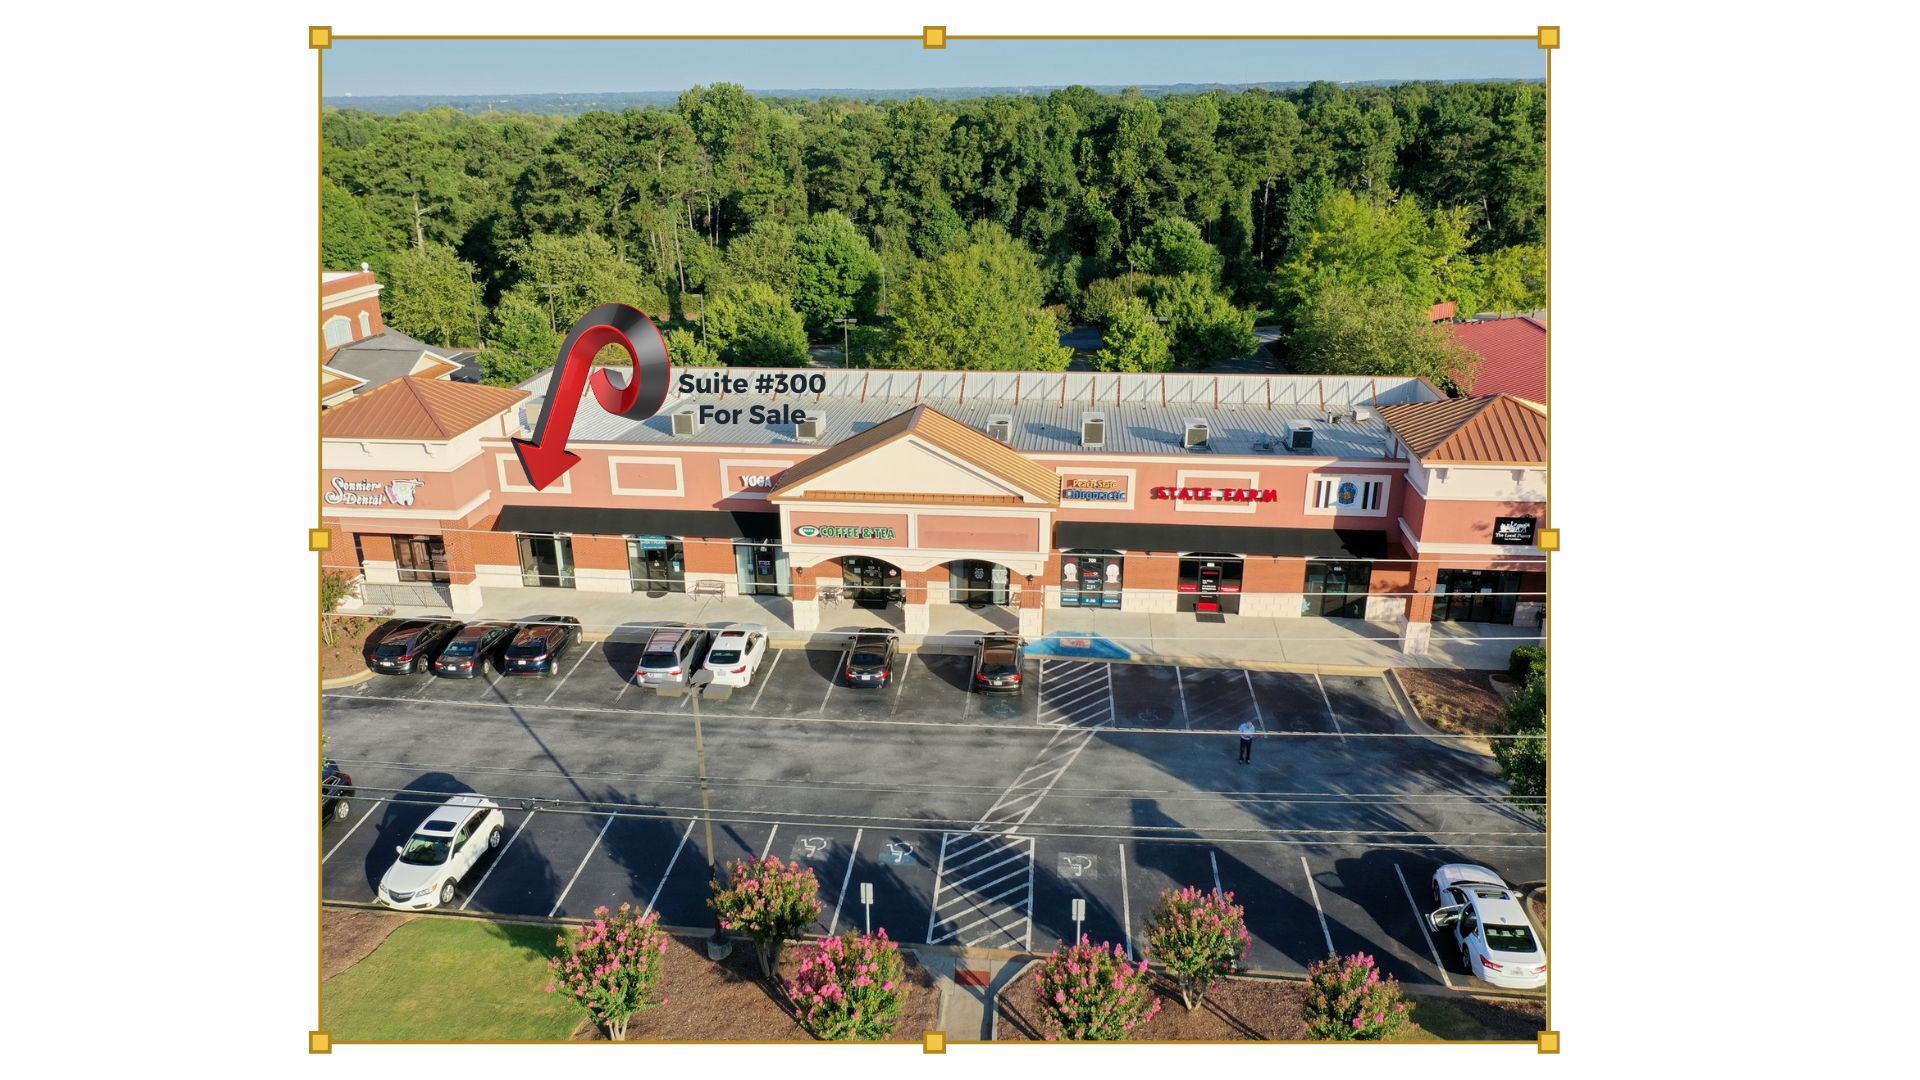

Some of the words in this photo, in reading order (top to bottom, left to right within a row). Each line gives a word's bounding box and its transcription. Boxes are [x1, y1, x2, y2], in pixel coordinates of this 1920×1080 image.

[741, 475, 773, 488] YOGA
[325, 477, 381, 504] Sonnier
[1156, 487, 1212, 501] STATE
[1223, 488, 1278, 503] FARM
[343, 492, 385, 505] Dental
[820, 526, 860, 538] COFFEE
[874, 527, 896, 540] TEA
